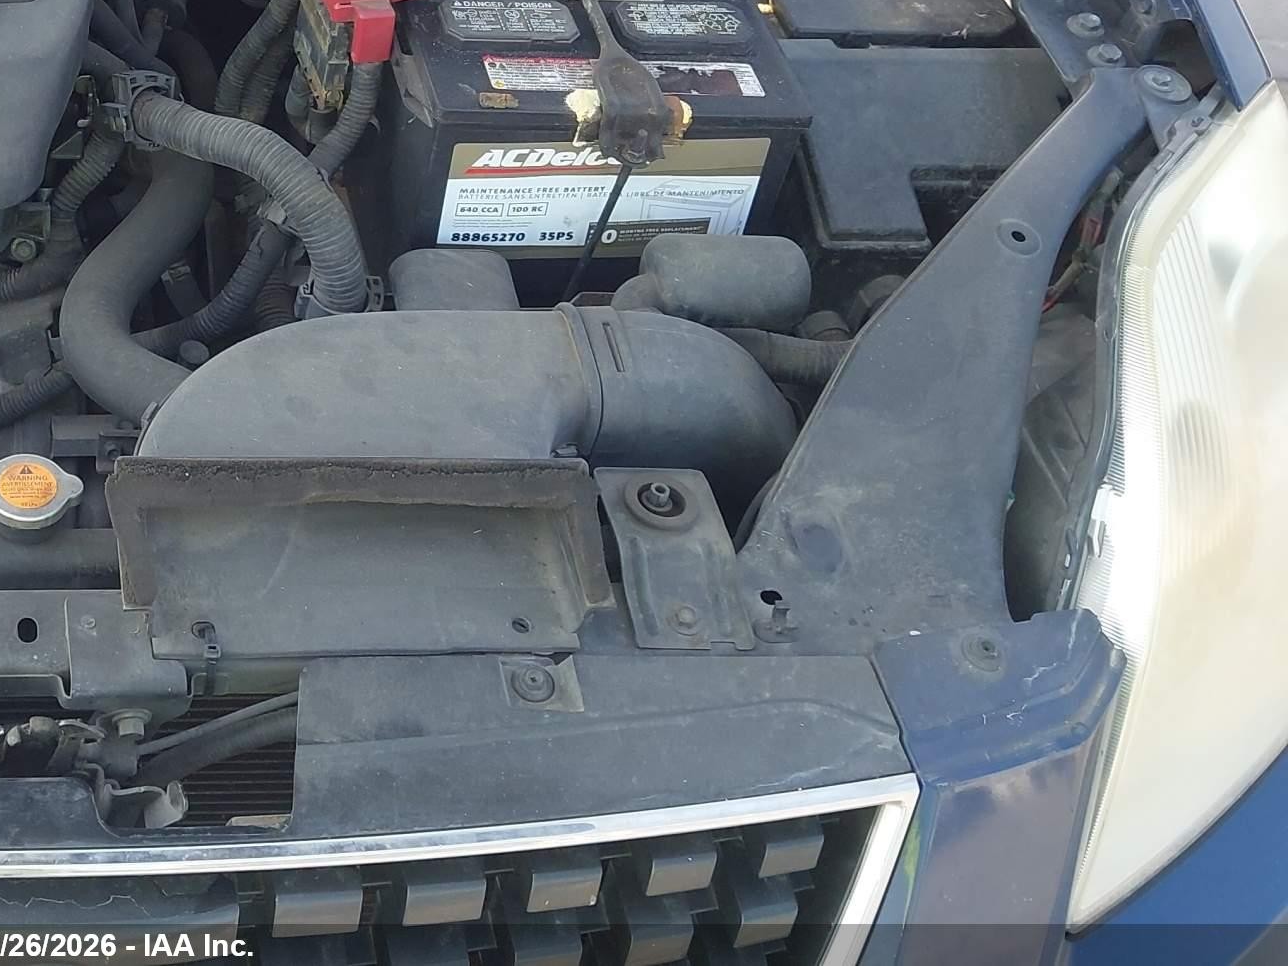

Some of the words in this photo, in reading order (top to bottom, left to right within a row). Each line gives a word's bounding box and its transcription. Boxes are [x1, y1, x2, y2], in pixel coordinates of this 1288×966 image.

[563, 185, 606, 193] BATTERY
[667, 189, 745, 197] MANTENIMIENTO
[450, 232, 526, 242] 88865270
[538, 231, 574, 241] 35PS
